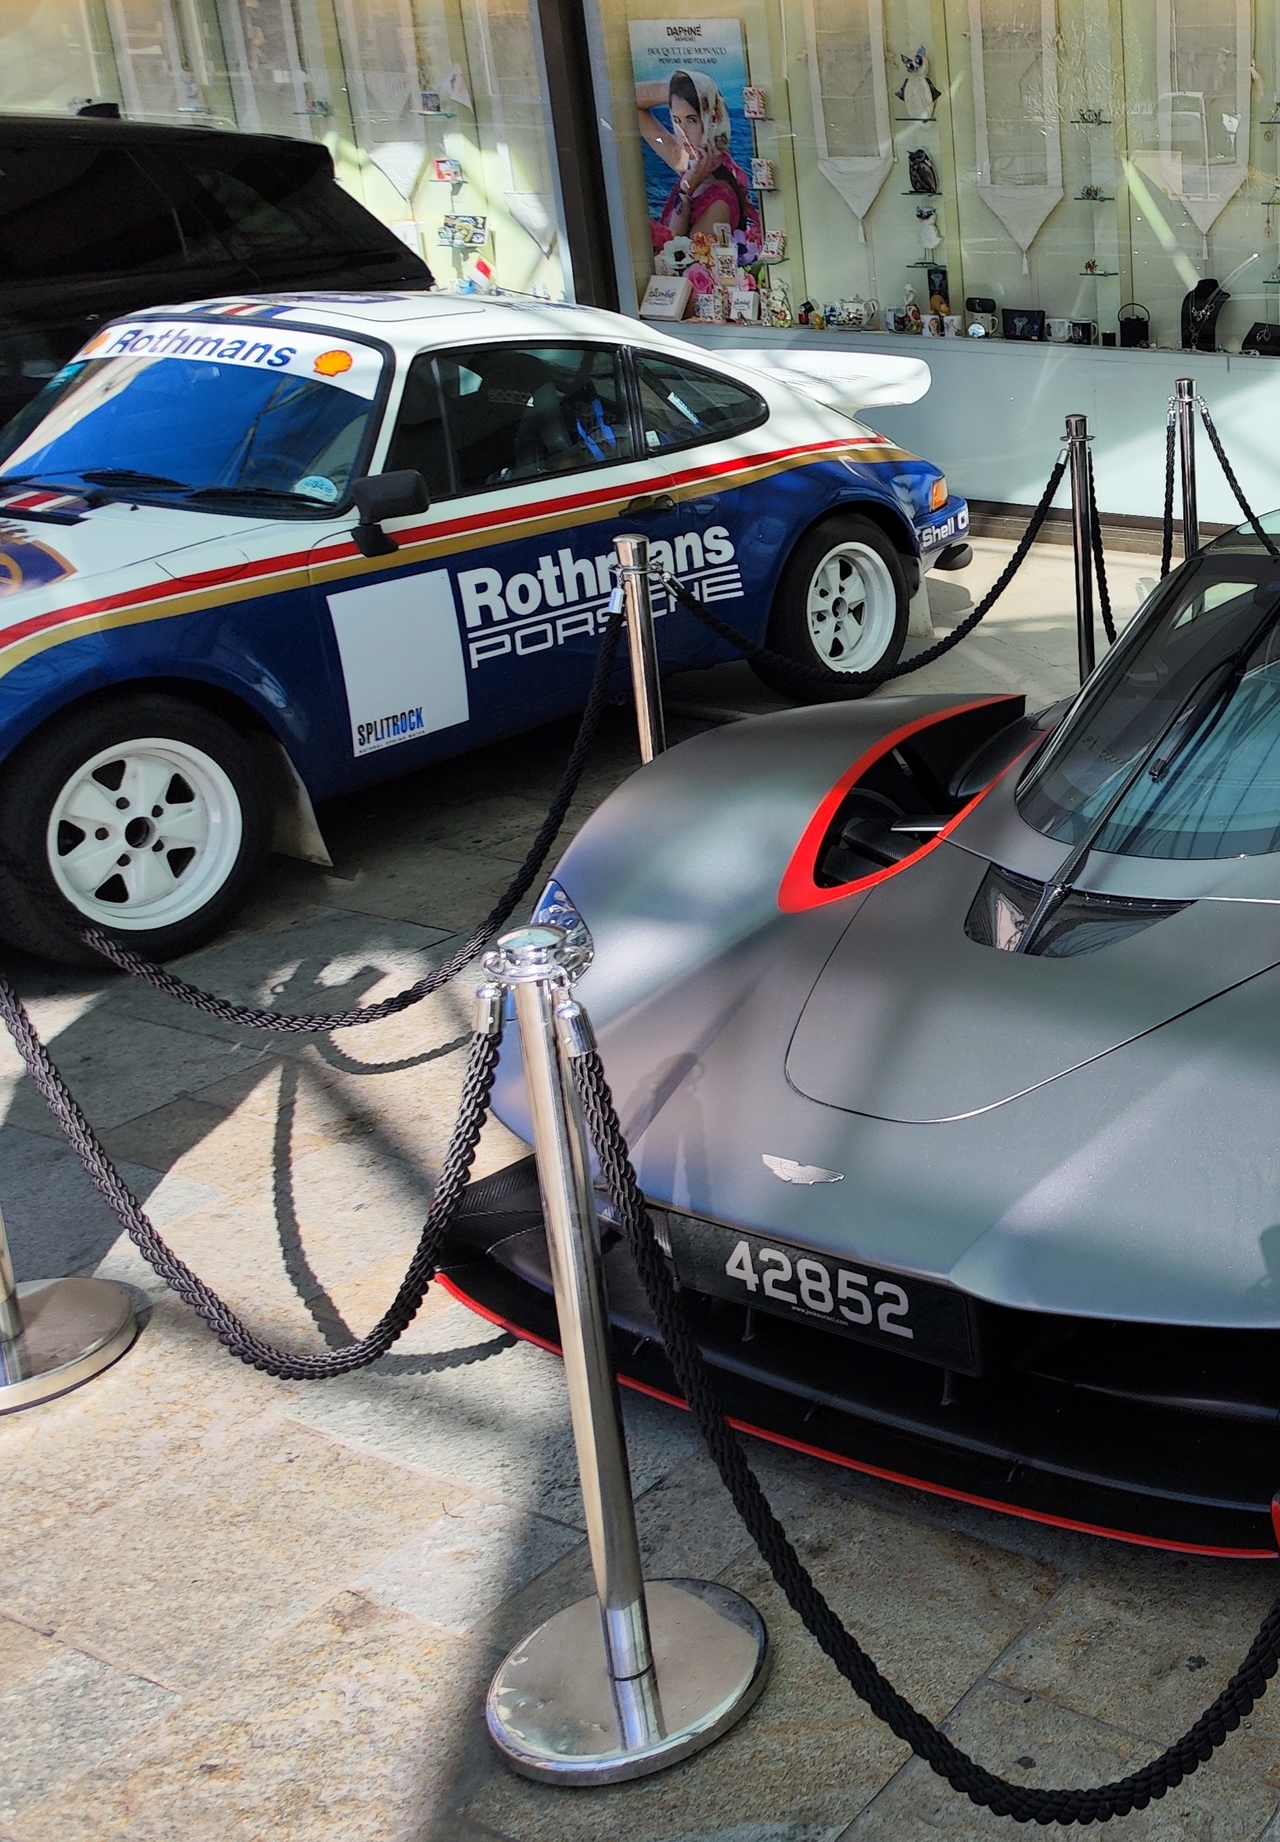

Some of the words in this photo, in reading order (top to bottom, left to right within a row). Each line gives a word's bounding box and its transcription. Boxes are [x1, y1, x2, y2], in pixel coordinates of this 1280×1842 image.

[666, 24, 703, 36] DAPHNÉ
[105, 328, 298, 367] Rothmans
[922, 516, 955, 548] Shell
[357, 706, 425, 747] SPLITROCK
[725, 1240, 914, 1340] 42852
